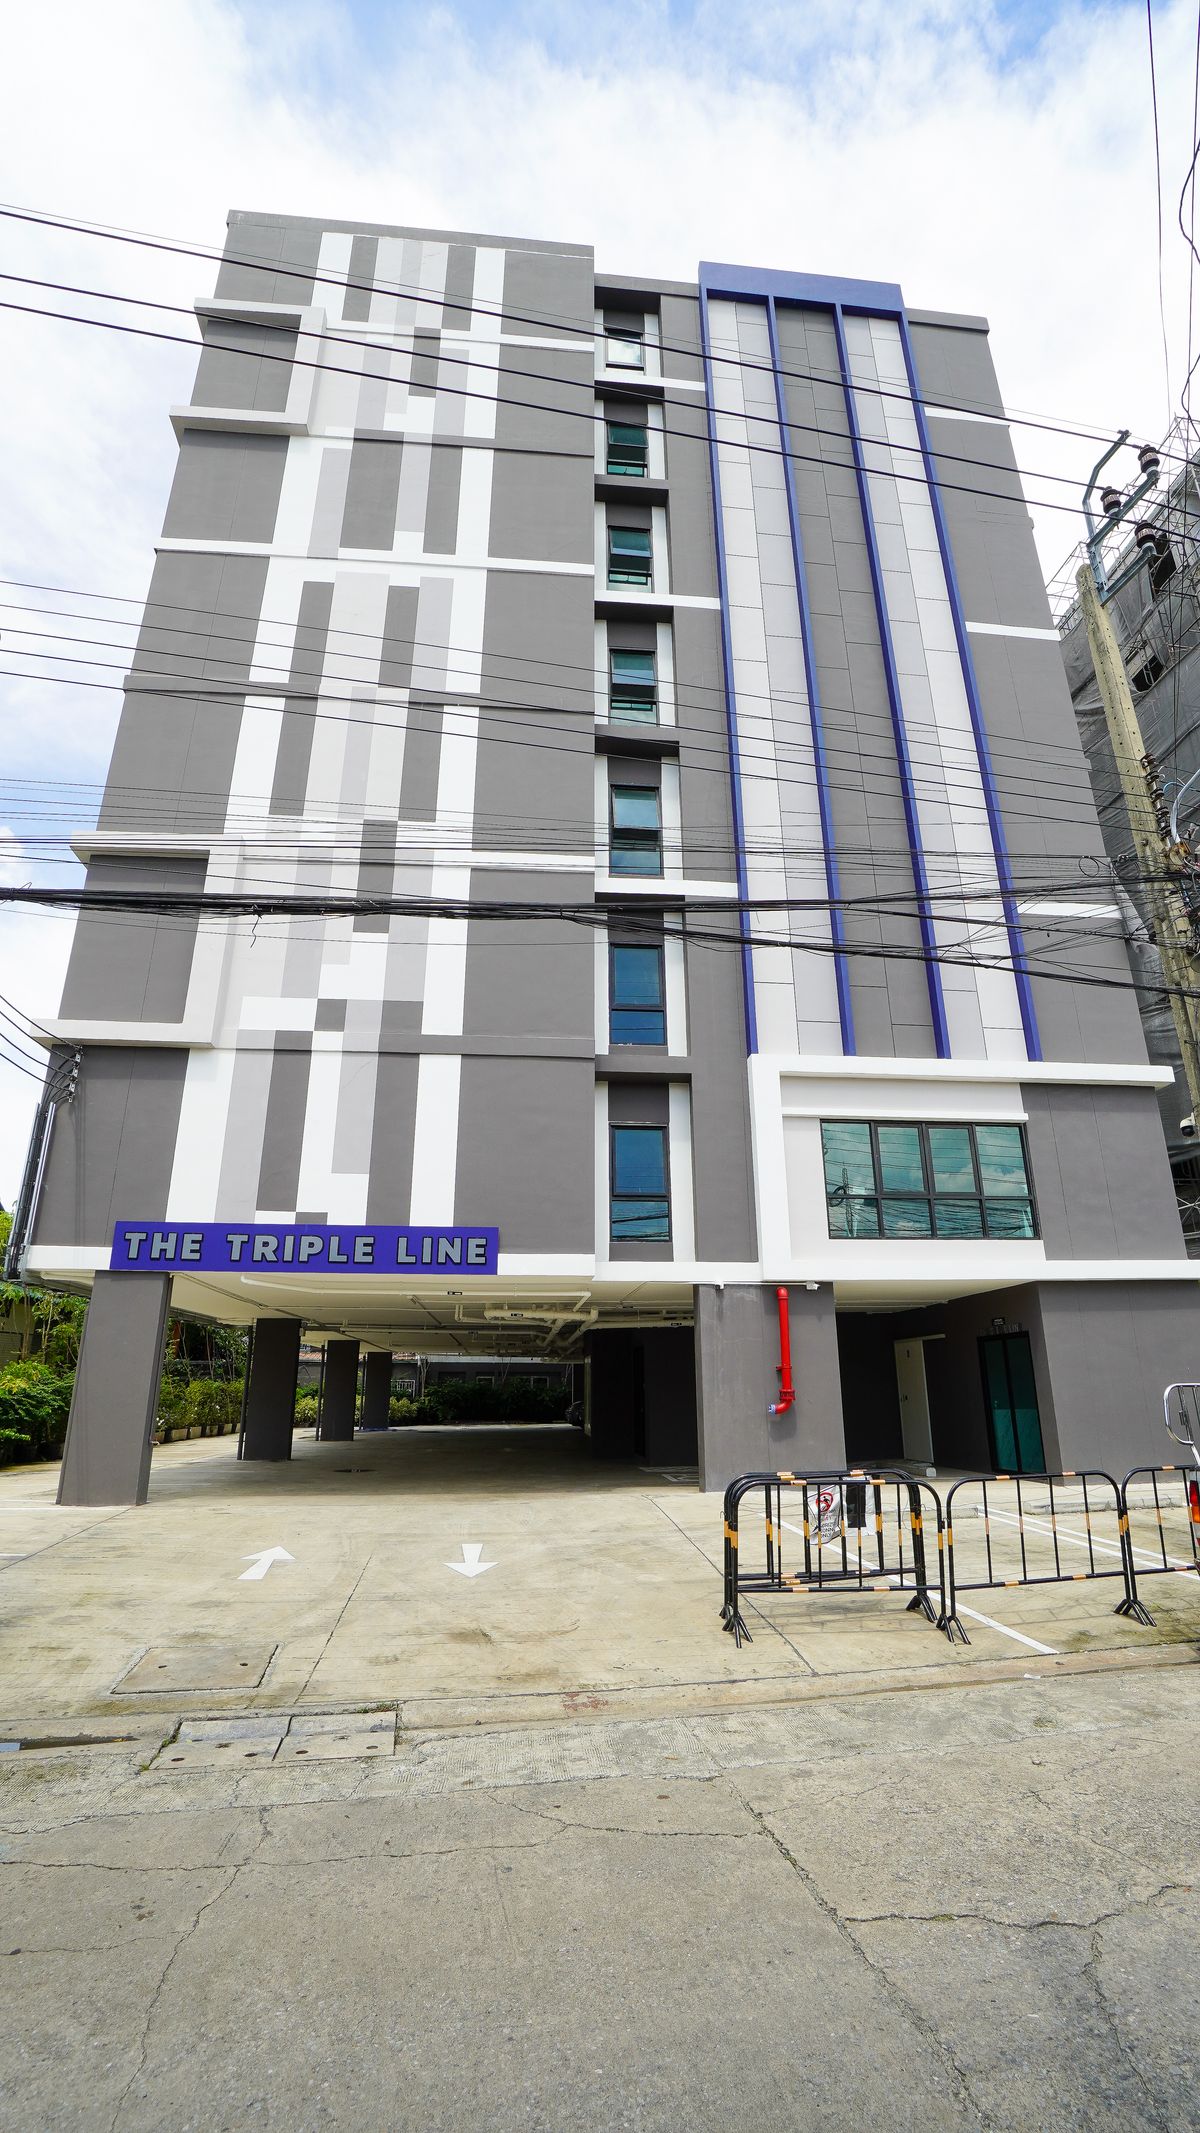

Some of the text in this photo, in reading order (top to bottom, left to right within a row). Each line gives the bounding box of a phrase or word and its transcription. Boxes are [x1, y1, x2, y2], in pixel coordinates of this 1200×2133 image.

[124, 1232, 488, 1264] THE TRIPLE LINE
